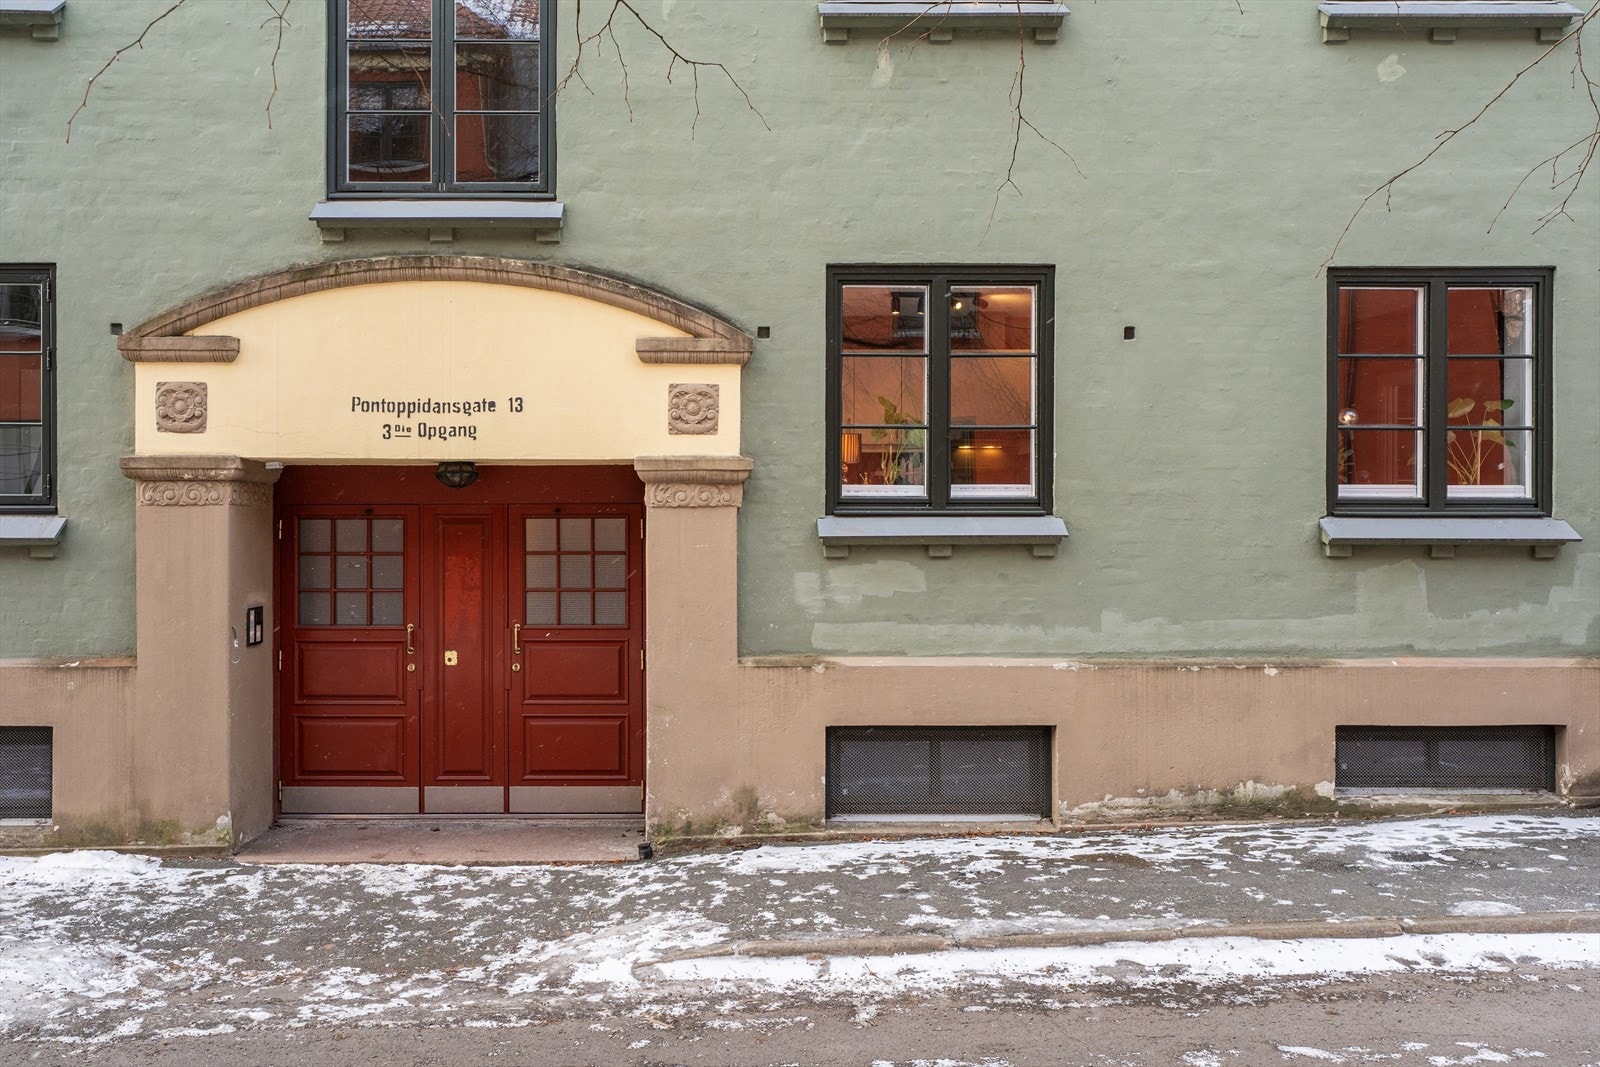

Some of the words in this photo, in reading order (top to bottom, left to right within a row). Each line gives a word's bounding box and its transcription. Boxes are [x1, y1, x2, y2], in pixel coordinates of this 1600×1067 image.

[351, 396, 497, 418] Pontoppidansgate
[508, 396, 524, 413] 13
[417, 422, 477, 441] Opgang
